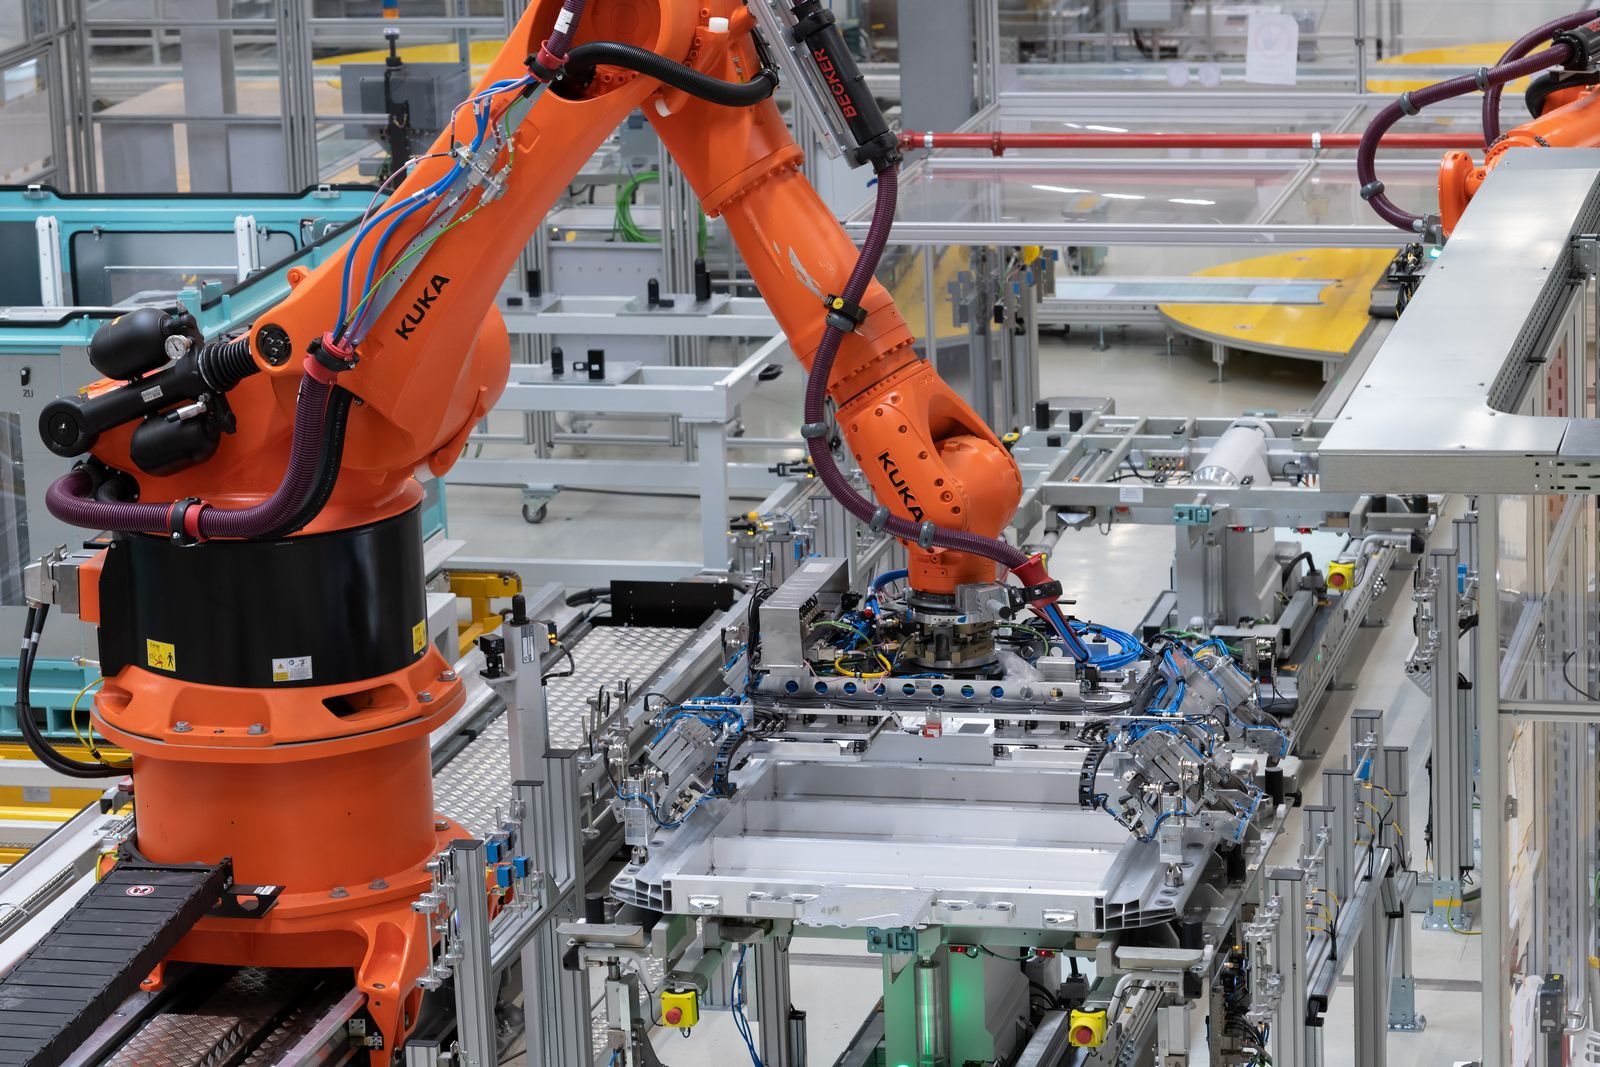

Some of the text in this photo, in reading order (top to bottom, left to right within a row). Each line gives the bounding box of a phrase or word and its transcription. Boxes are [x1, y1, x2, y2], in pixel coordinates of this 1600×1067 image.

[814, 48, 857, 118] BECKER
[395, 275, 450, 340] KUKA
[878, 451, 924, 522] KUKA
